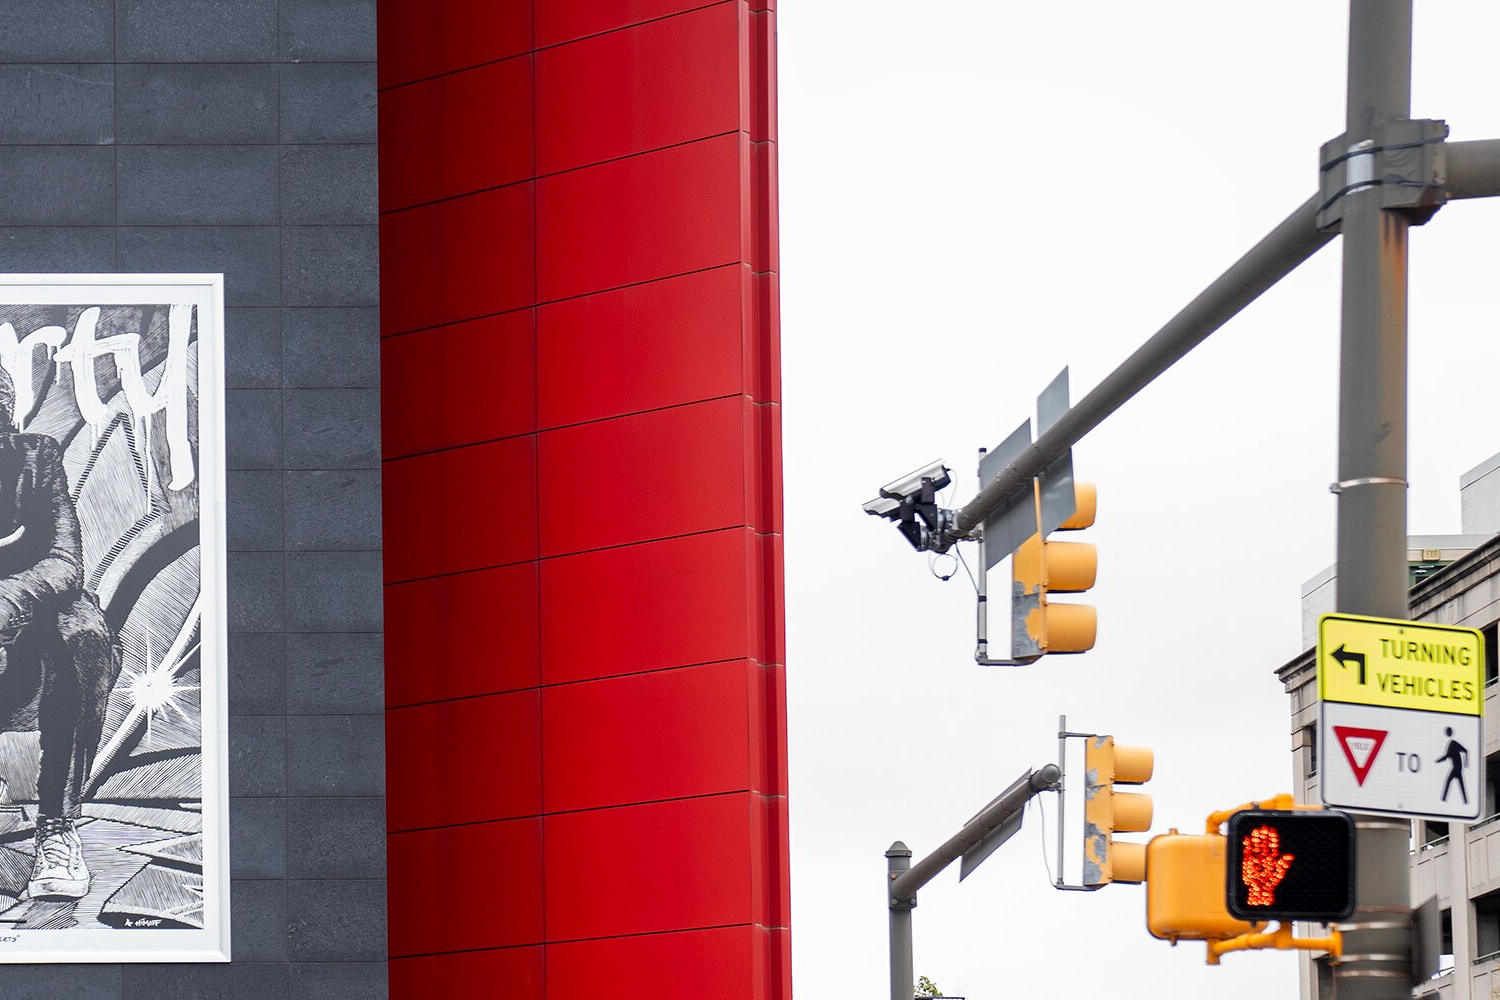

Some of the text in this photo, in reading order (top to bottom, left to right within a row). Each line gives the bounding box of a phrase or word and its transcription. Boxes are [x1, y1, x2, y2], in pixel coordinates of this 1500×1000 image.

[1380, 638, 1472, 666] TURNING
[1376, 672, 1476, 701] VEHICLES
[1396, 752, 1421, 773] TO
